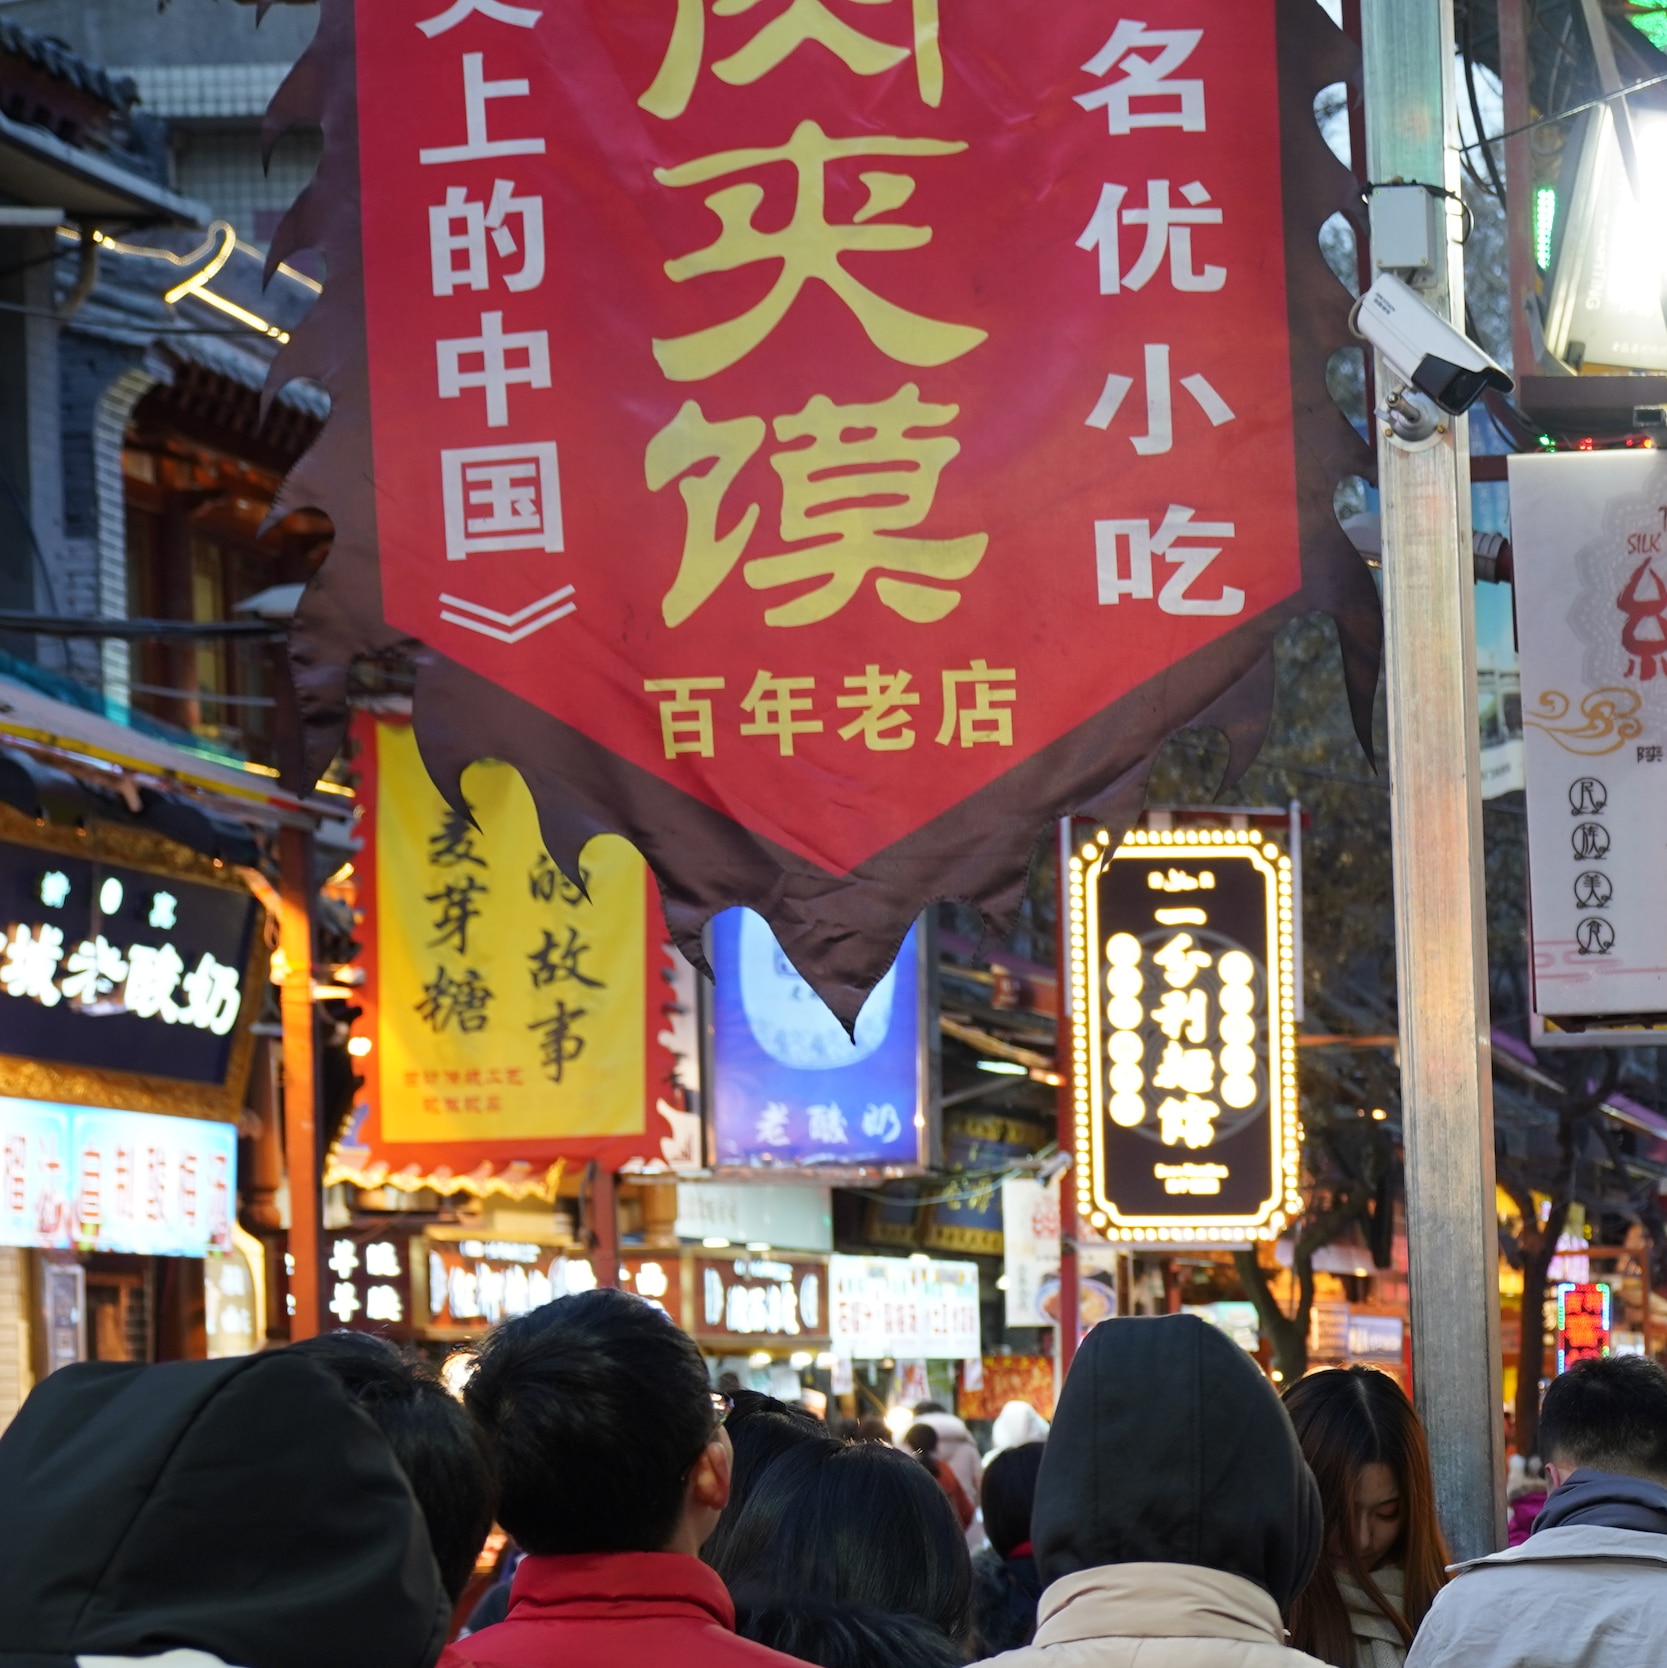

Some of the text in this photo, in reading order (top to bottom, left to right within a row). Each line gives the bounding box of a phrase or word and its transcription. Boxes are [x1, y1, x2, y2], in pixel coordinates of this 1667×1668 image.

[1073, 19, 1246, 617] 名优小吃
[1627, 532, 1663, 555] SILK
[644, 658, 1016, 761] 百年老店
[412, 800, 496, 1036] 麦芽糖
[1568, 776, 1617, 956] 民族美食
[527, 852, 607, 1084] 的故事
[755, 1100, 901, 1147] 老酸奶
